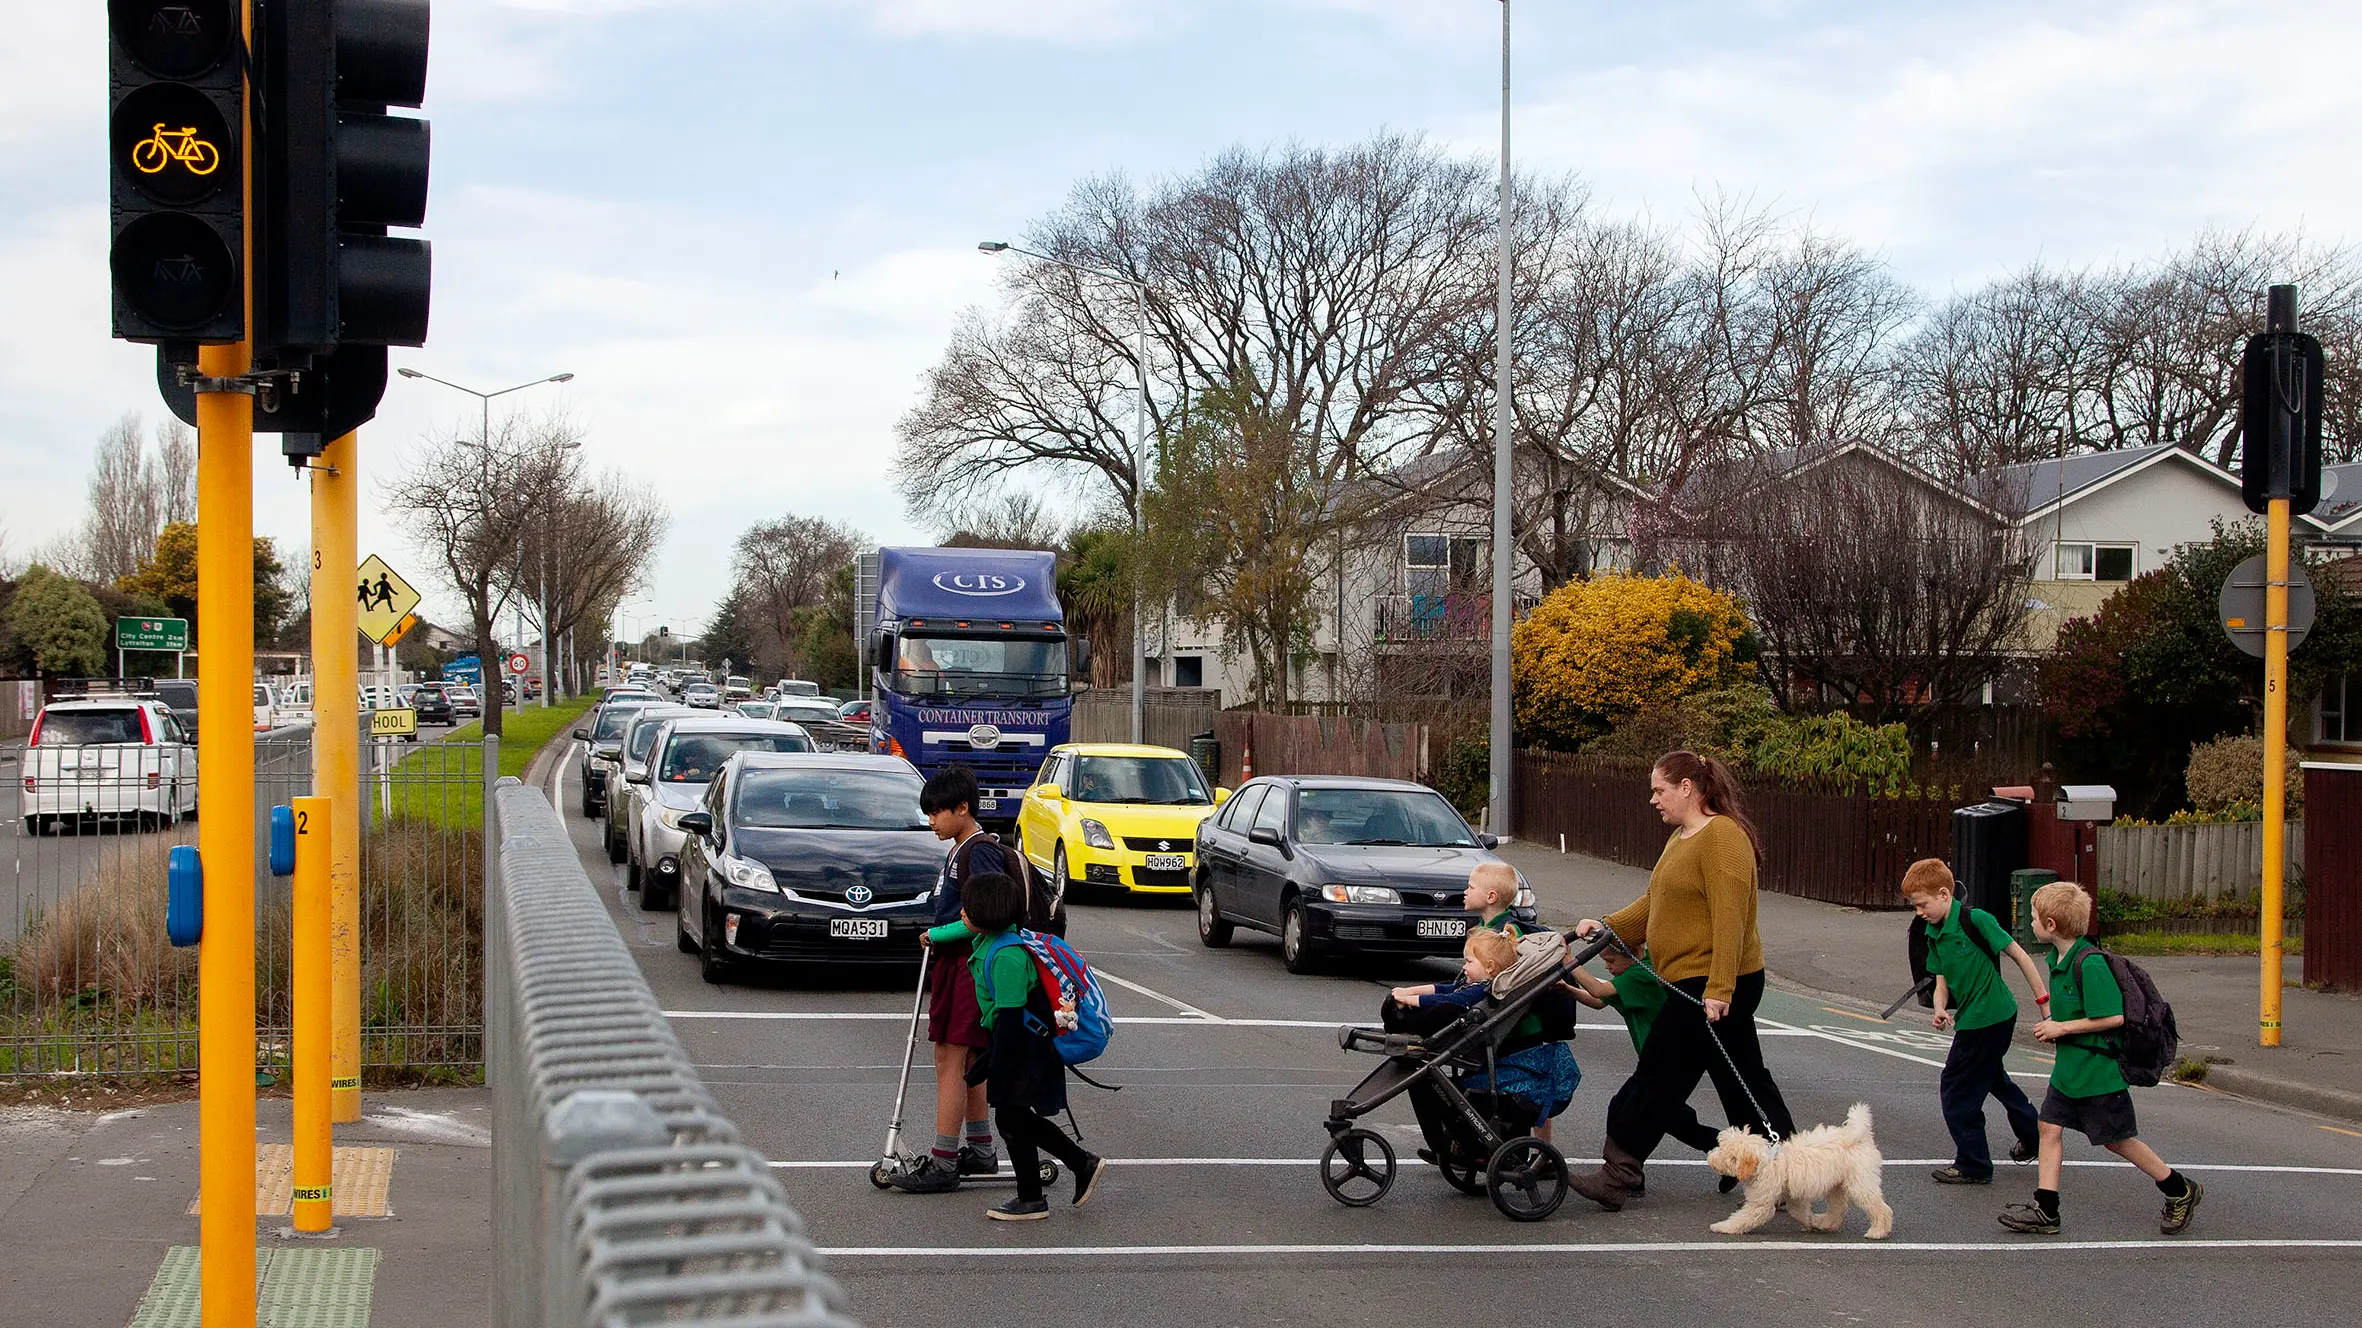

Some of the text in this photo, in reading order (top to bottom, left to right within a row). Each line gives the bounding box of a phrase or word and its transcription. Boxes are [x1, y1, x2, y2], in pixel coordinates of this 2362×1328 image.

[314, 550, 322, 570] 3
[120, 632, 137, 640] City
[513, 660, 525, 668] 60
[2268, 679, 2276, 693] 5
[373, 715, 407, 729] HOOL
[918, 709, 1051, 725] CONTAINER TRANSPORT
[297, 811, 308, 835] 2
[1147, 857, 1184, 868] HQW962
[832, 920, 885, 936] MQA531
[1418, 921, 1465, 935] BHN193
[331, 1078, 357, 1088] WIRES
